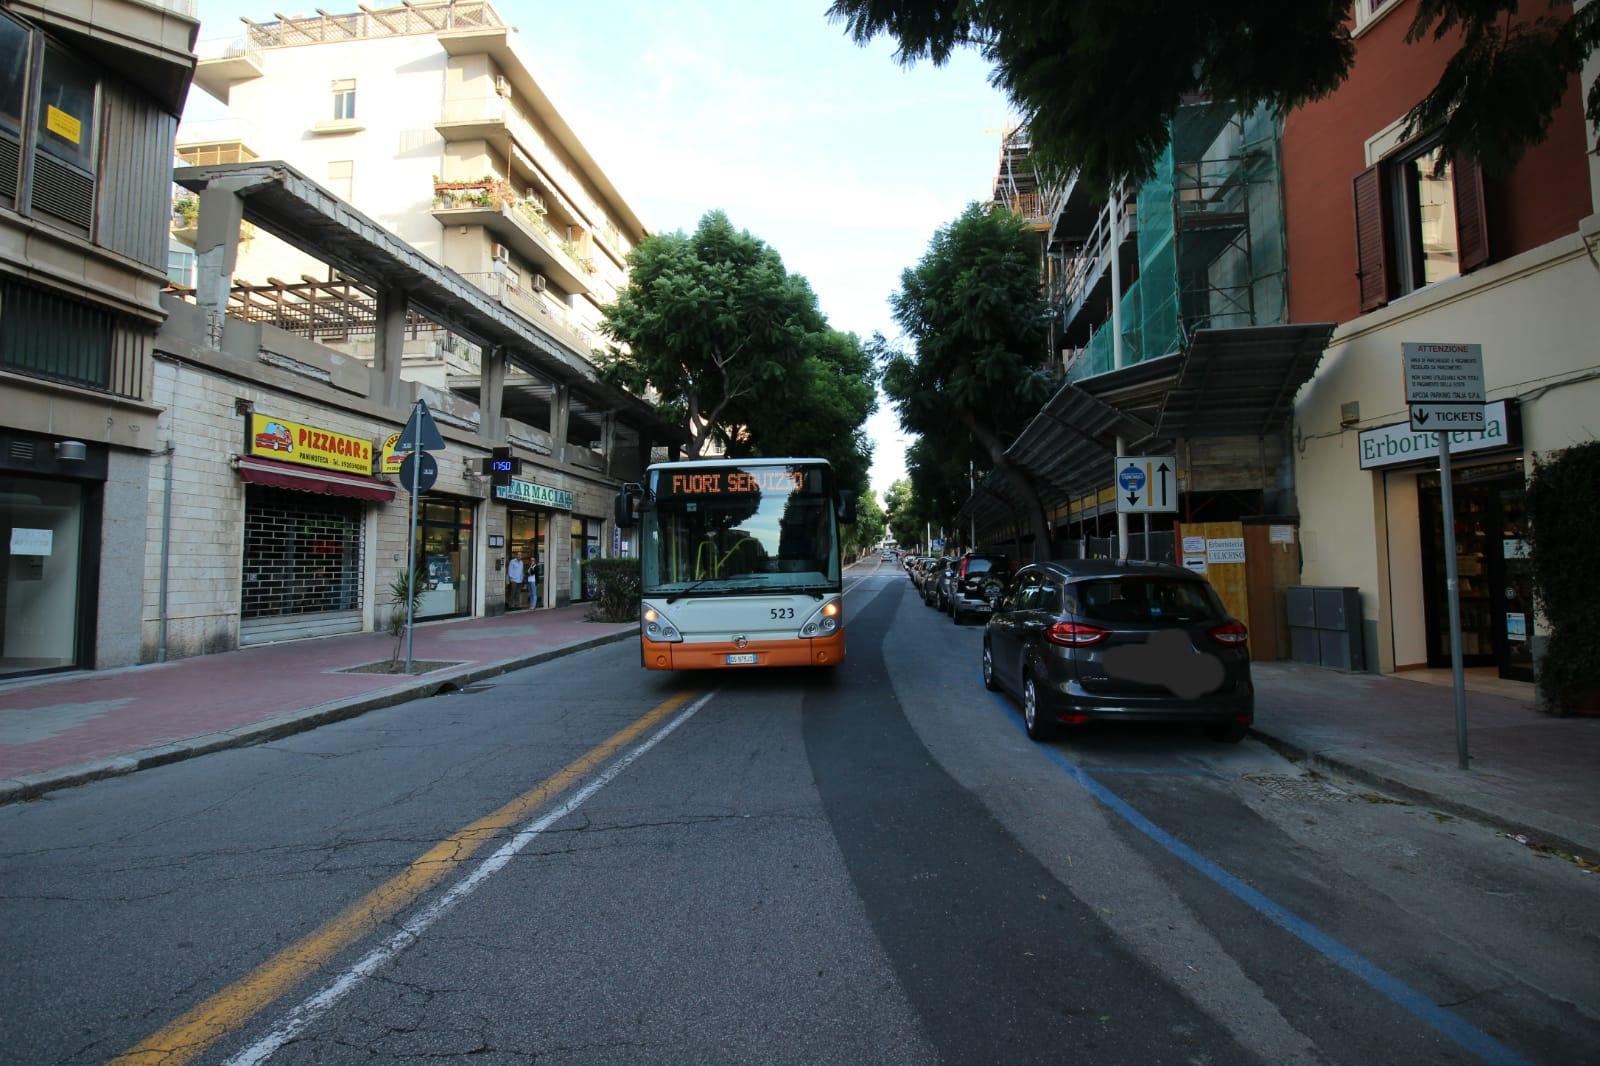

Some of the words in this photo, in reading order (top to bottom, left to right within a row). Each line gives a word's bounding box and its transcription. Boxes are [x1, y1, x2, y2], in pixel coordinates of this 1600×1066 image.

[1429, 391, 1451, 399] PARKING
[1435, 412, 1483, 421] TICKETS
[298, 428, 361, 459] PIZZACAR
[362, 447, 368, 460] 2
[299, 451, 329, 464] PANINOTECA
[672, 473, 721, 494] FUORI
[727, 471, 803, 492] SERVIZIO
[508, 481, 566, 503] FARMACIA
[770, 607, 795, 620] 523
